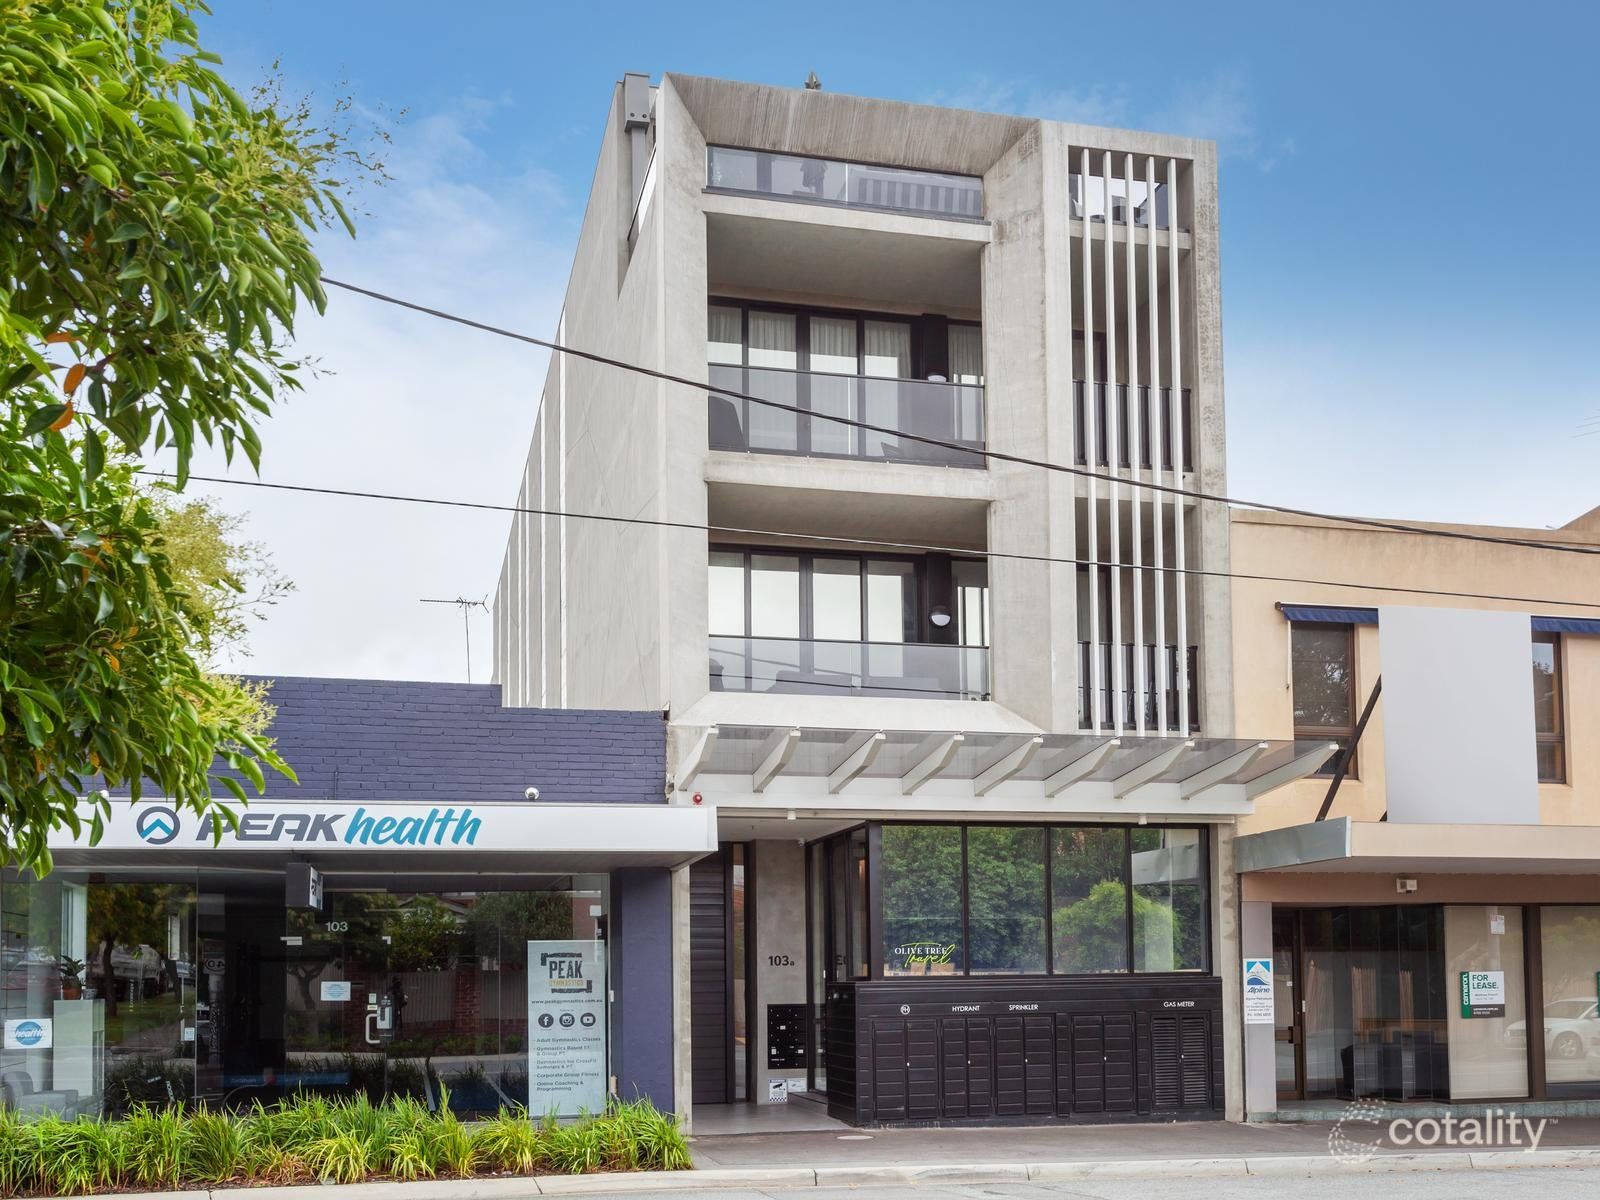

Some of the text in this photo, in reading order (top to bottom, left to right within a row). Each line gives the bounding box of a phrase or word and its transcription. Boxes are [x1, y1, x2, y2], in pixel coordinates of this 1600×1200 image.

[196, 807, 482, 846] PEAK health
[325, 921, 349, 932] 103
[894, 947, 947, 955] OLIVE TREE
[901, 942, 956, 968] Travel
[768, 955, 795, 966] 103a
[549, 960, 583, 978] PEAK
[1247, 986, 1271, 995] Alpine
[1009, 1003, 1039, 1011] SPRINKLER
